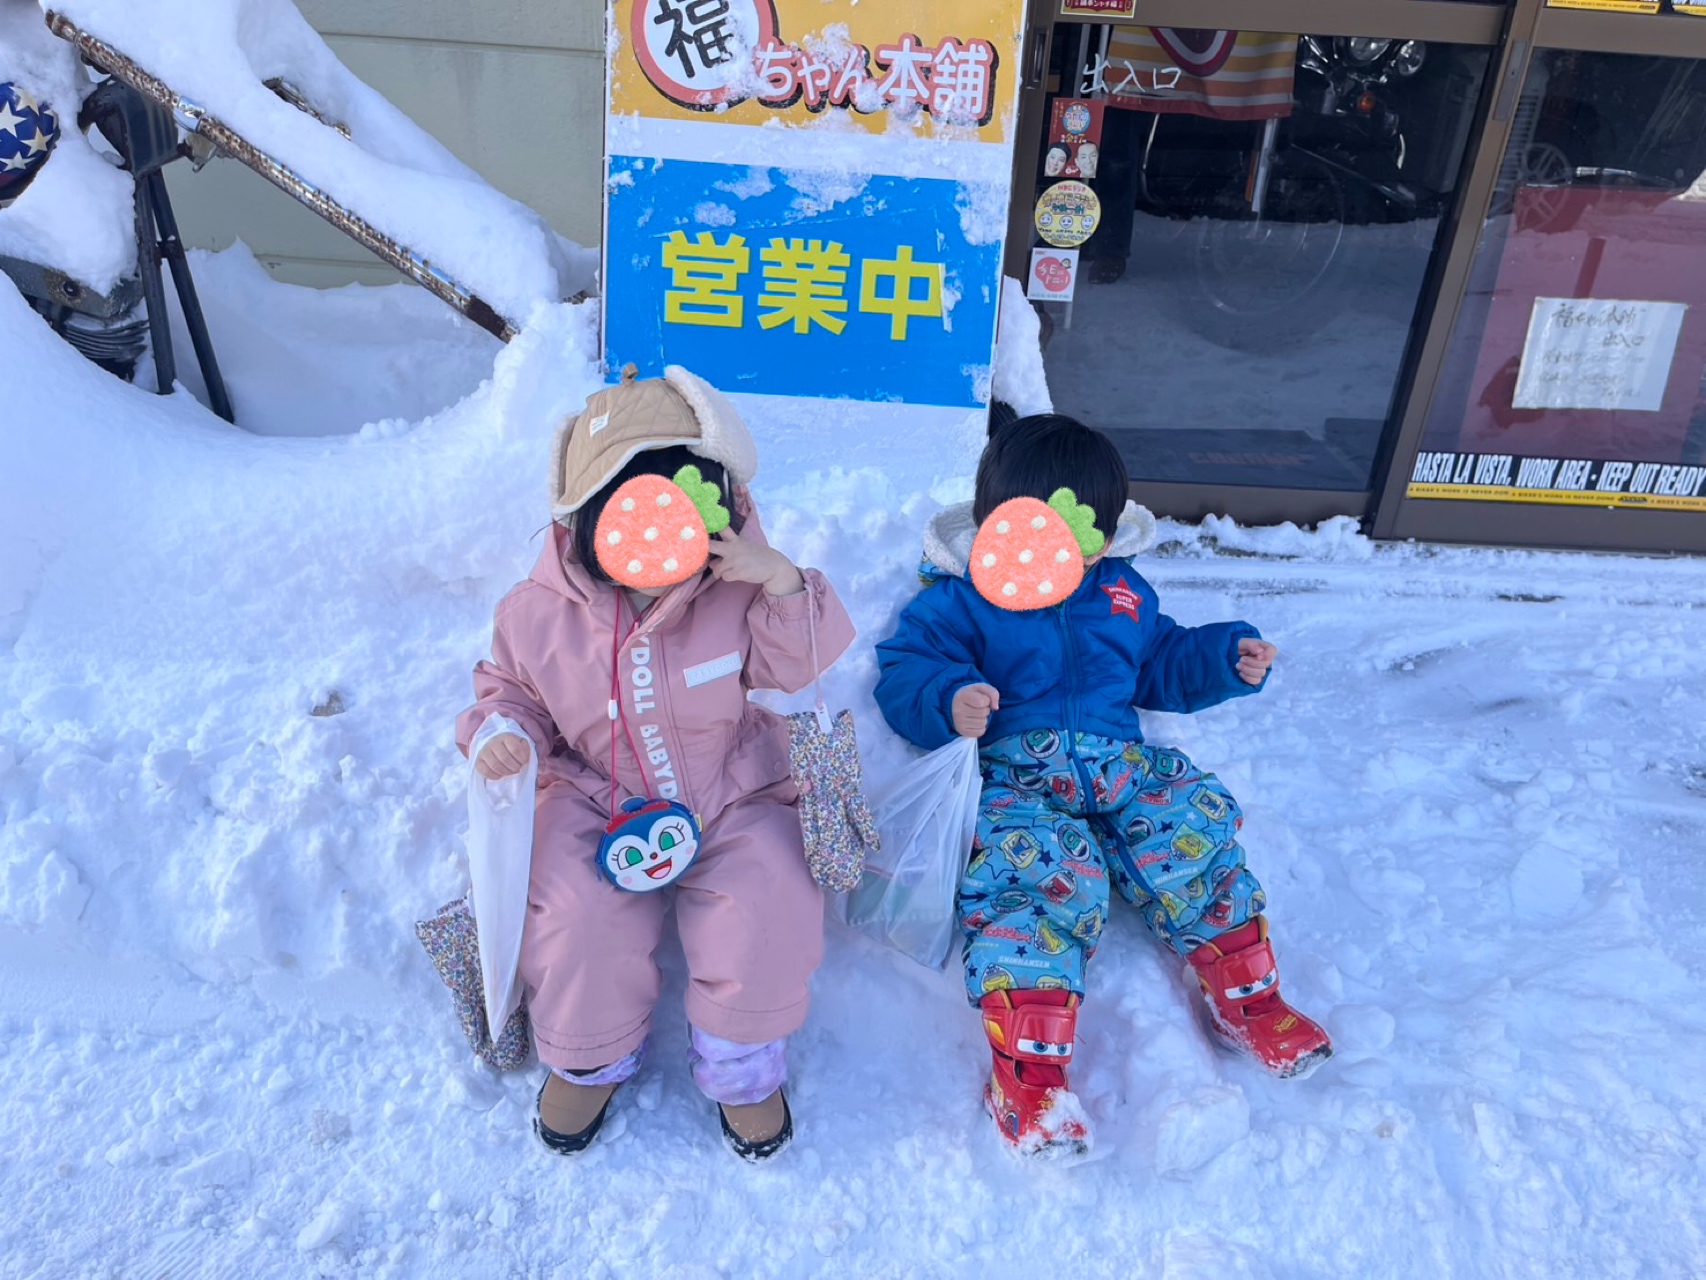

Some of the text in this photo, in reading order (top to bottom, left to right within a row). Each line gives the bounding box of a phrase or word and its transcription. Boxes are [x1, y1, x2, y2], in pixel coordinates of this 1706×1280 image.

[653, 0, 992, 115] 福 ちゃん本舗
[1079, 53, 1183, 94] 出入口
[661, 229, 945, 341] 営業中
[1411, 452, 1706, 497] HASTA LA VISTA, WORK AREA KEEP OUT READY
